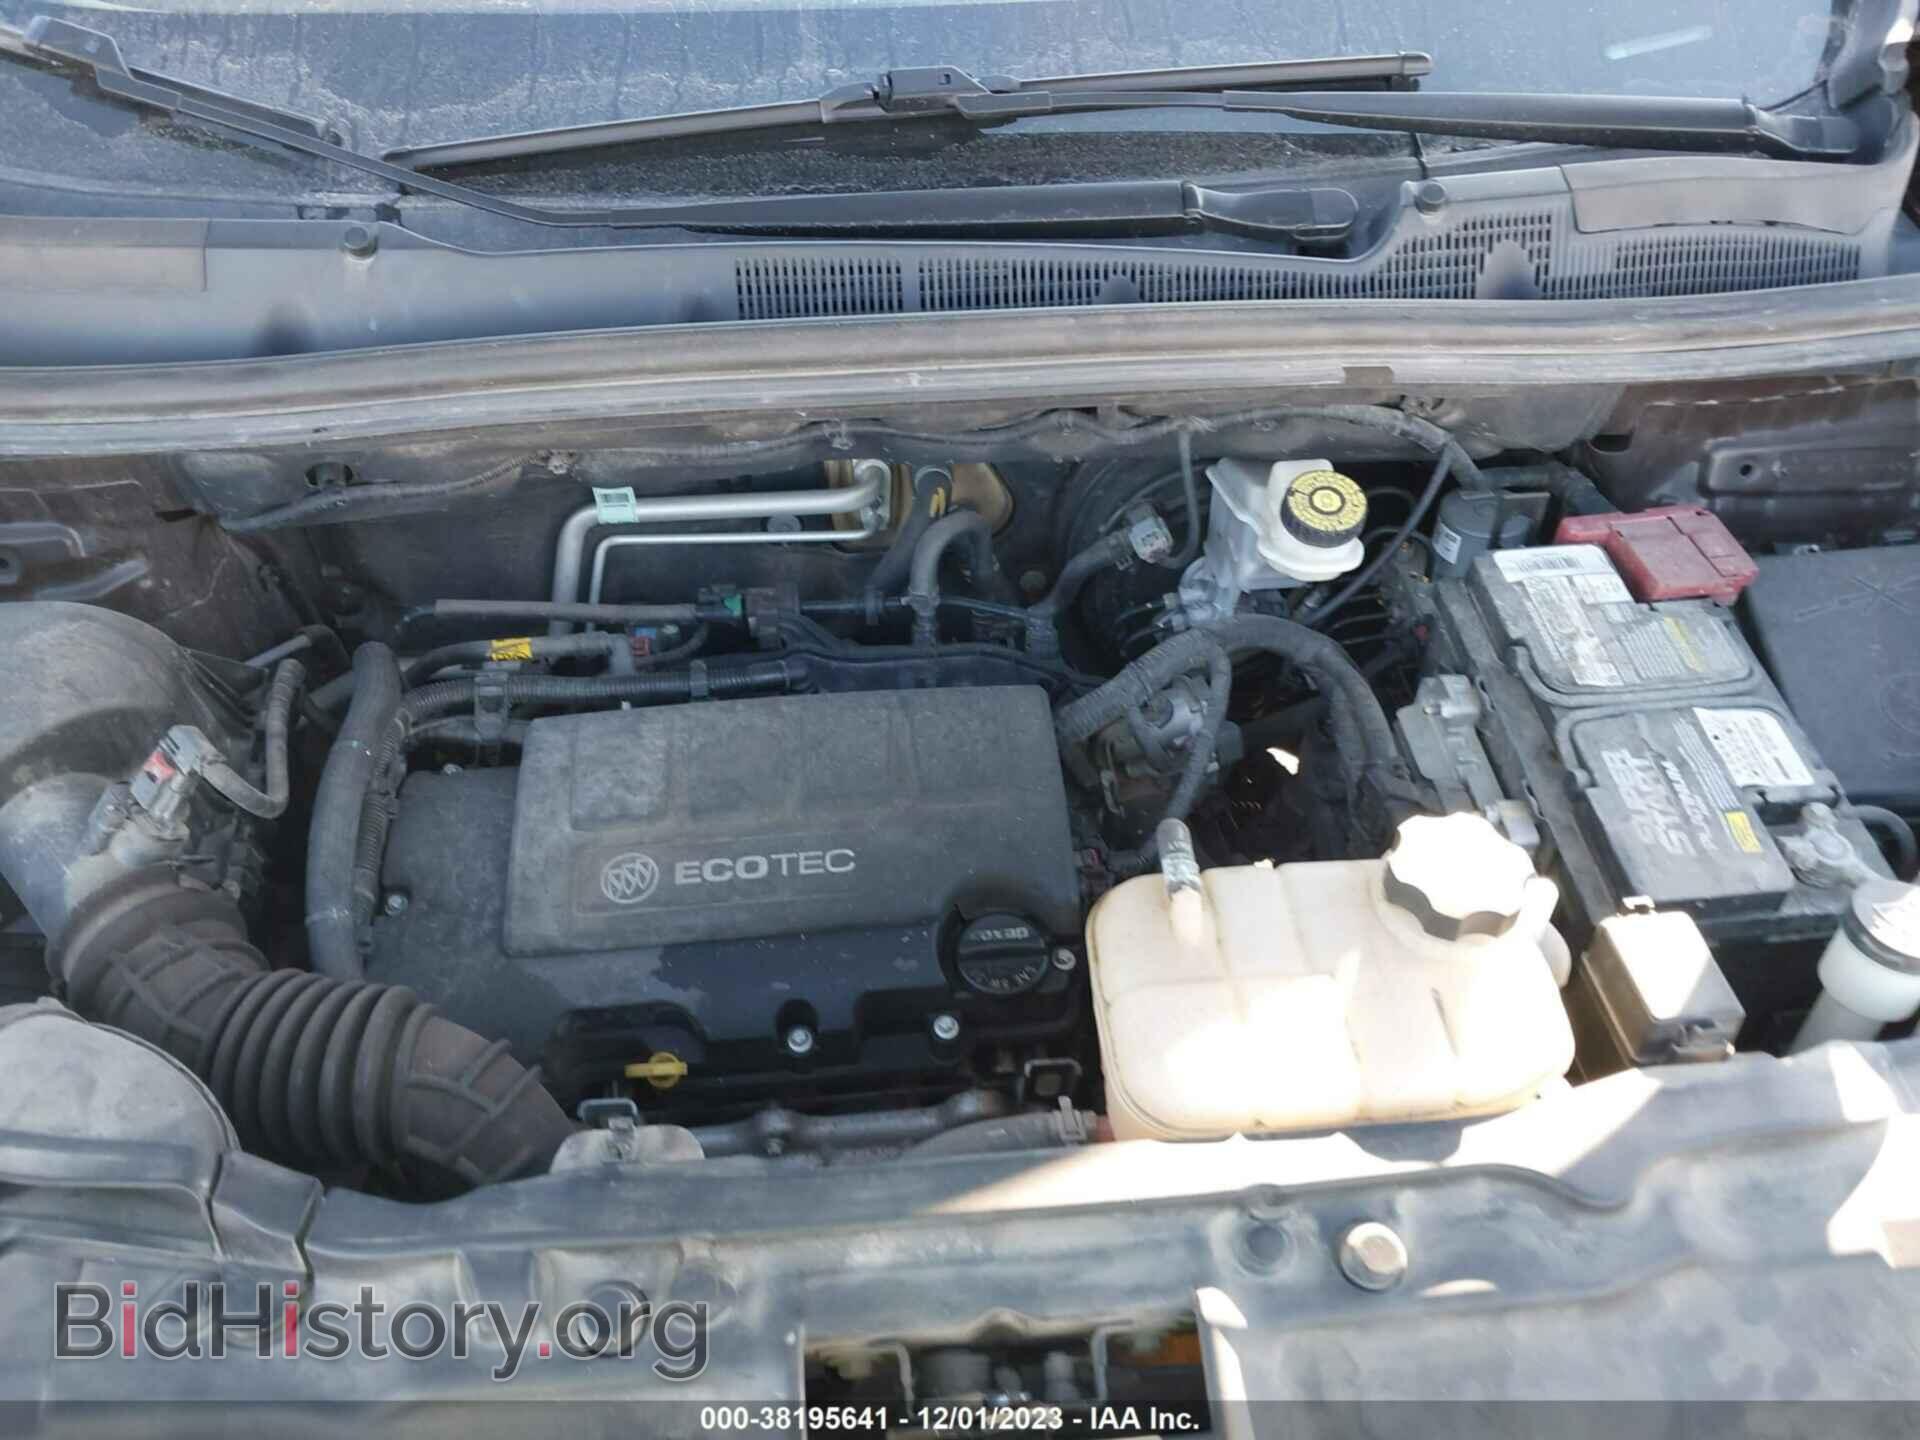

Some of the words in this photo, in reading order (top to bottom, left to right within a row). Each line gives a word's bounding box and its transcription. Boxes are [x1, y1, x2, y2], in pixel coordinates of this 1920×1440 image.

[1600, 748, 1659, 845] SUPER
[1624, 754, 1696, 854] START
[674, 848, 856, 885] ECOTEC
